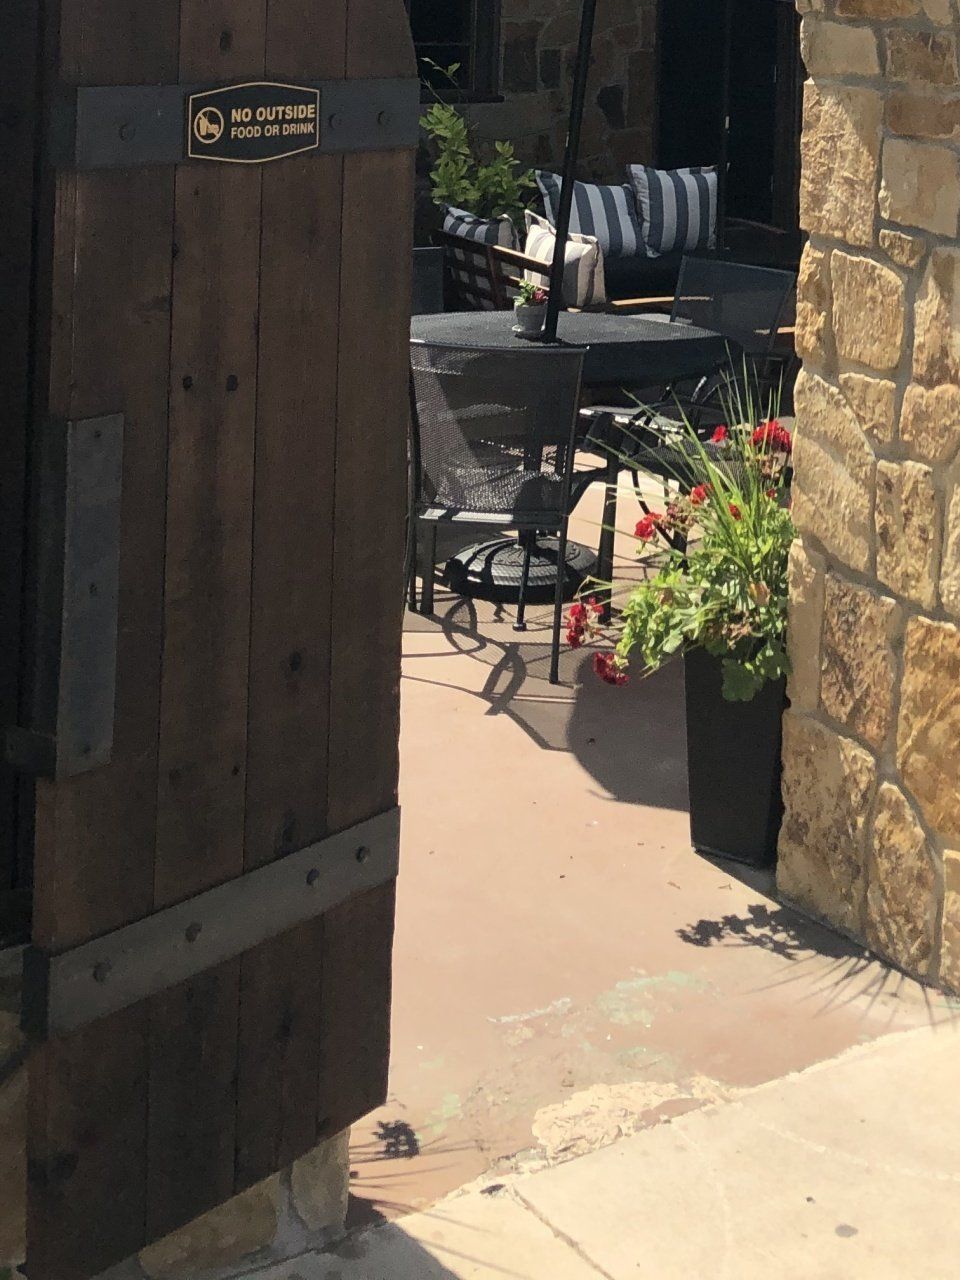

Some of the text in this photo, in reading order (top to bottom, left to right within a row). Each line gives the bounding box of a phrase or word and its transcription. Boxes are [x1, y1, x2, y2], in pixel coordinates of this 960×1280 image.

[231, 104, 316, 123] NO OUTSIDE
[231, 122, 315, 139] FOOD OR DRINK
